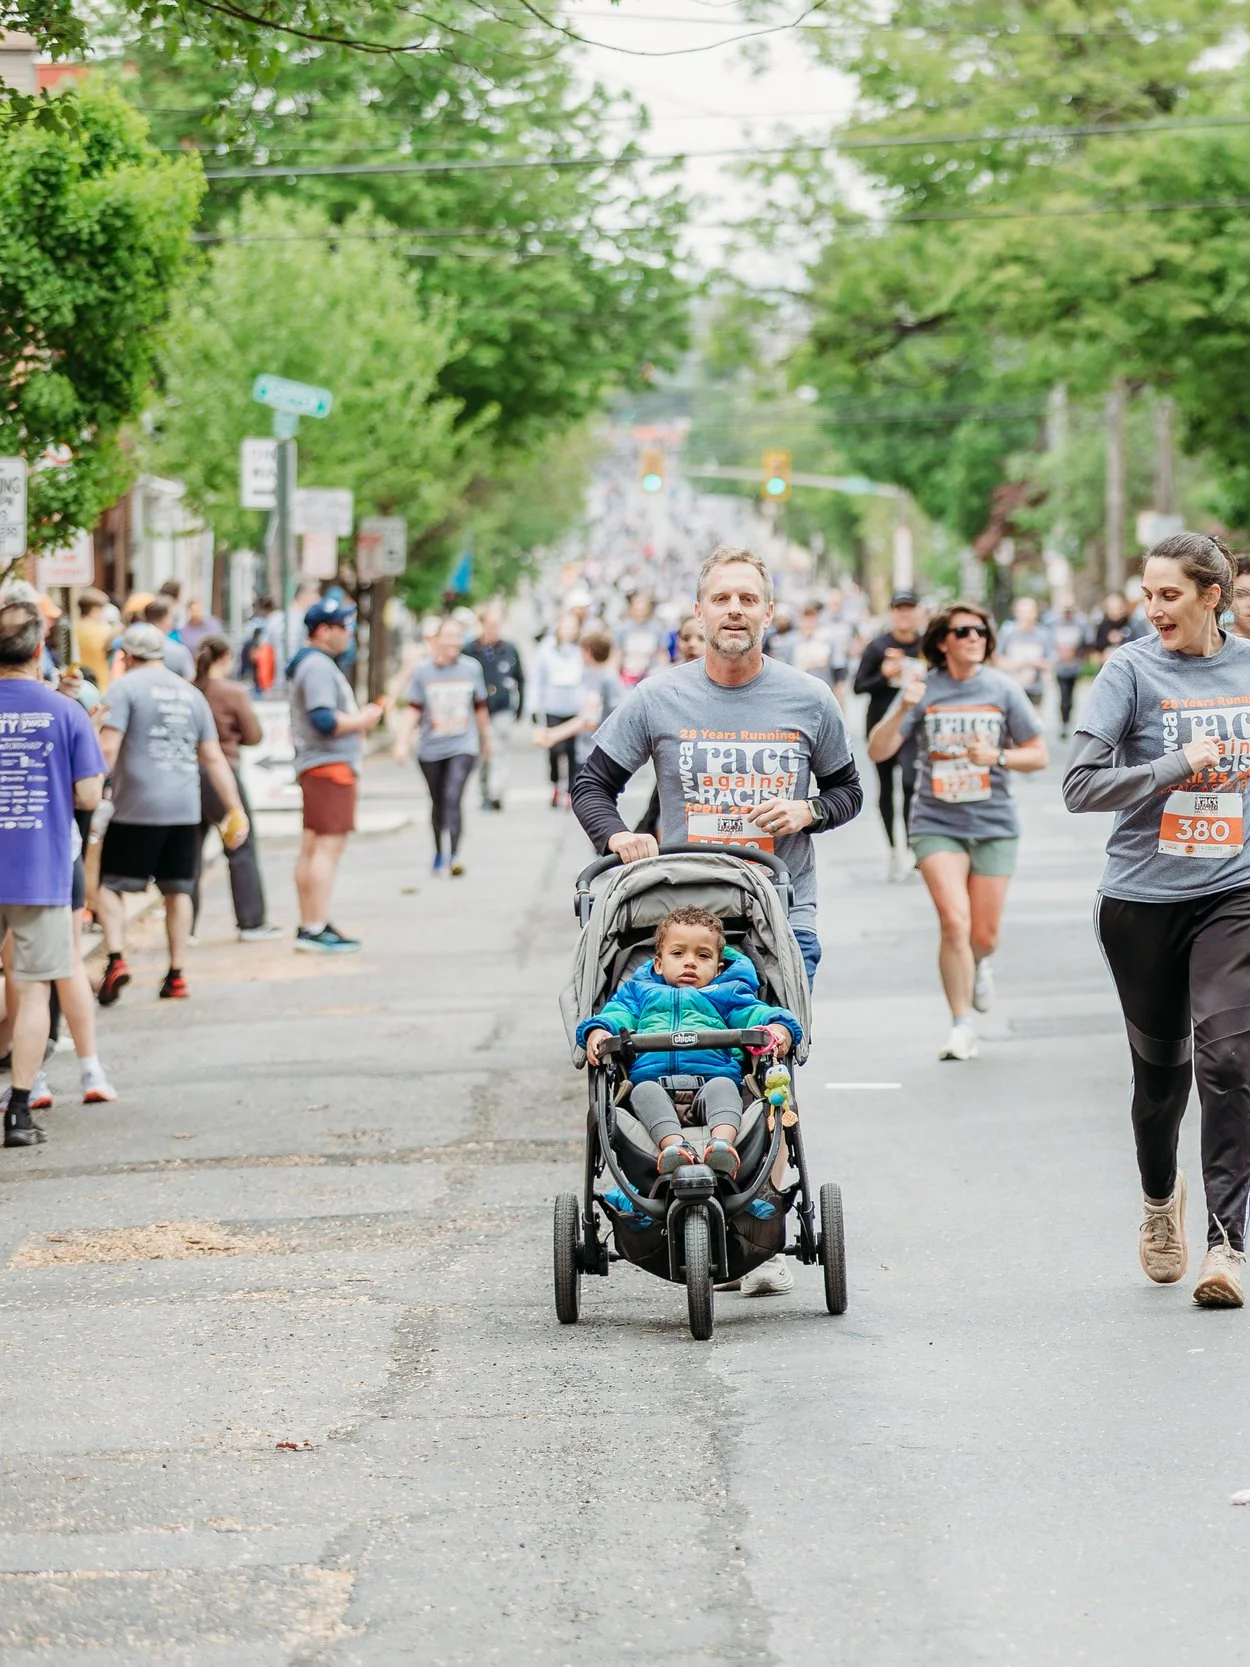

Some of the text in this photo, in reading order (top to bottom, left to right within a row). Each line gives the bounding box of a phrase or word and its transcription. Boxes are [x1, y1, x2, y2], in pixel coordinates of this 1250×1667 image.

[679, 728, 800, 743] 28 Years Running!
[679, 741, 700, 801] ywca
[697, 747, 800, 775] race
[702, 773, 794, 791] against
[1175, 819, 1230, 842] 380
[674, 1033, 696, 1043] chicco
